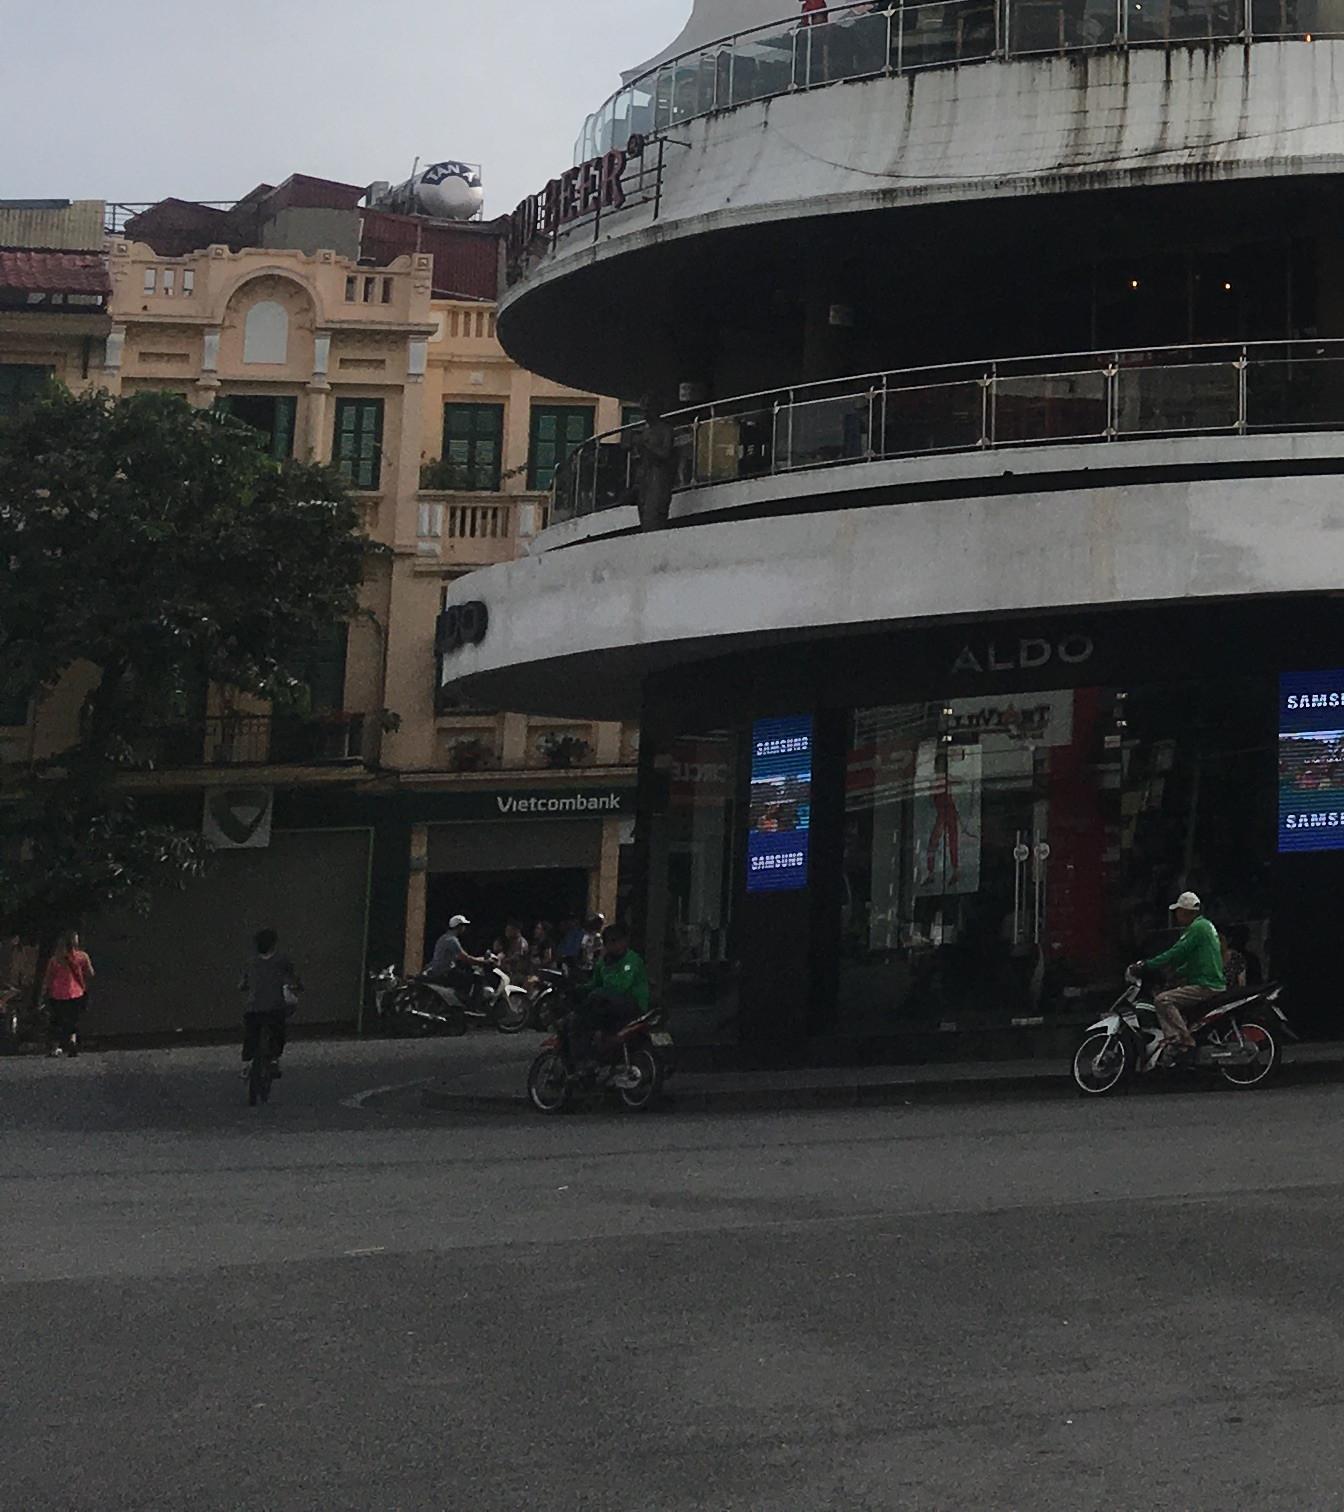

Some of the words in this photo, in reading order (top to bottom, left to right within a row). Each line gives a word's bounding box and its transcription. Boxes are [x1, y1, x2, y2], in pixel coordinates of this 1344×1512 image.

[949, 633, 1095, 674] ALDO
[756, 735, 809, 756] SAMSUNG
[496, 791, 621, 813] Vietcombank
[751, 851, 804, 871] SAMSUNG
